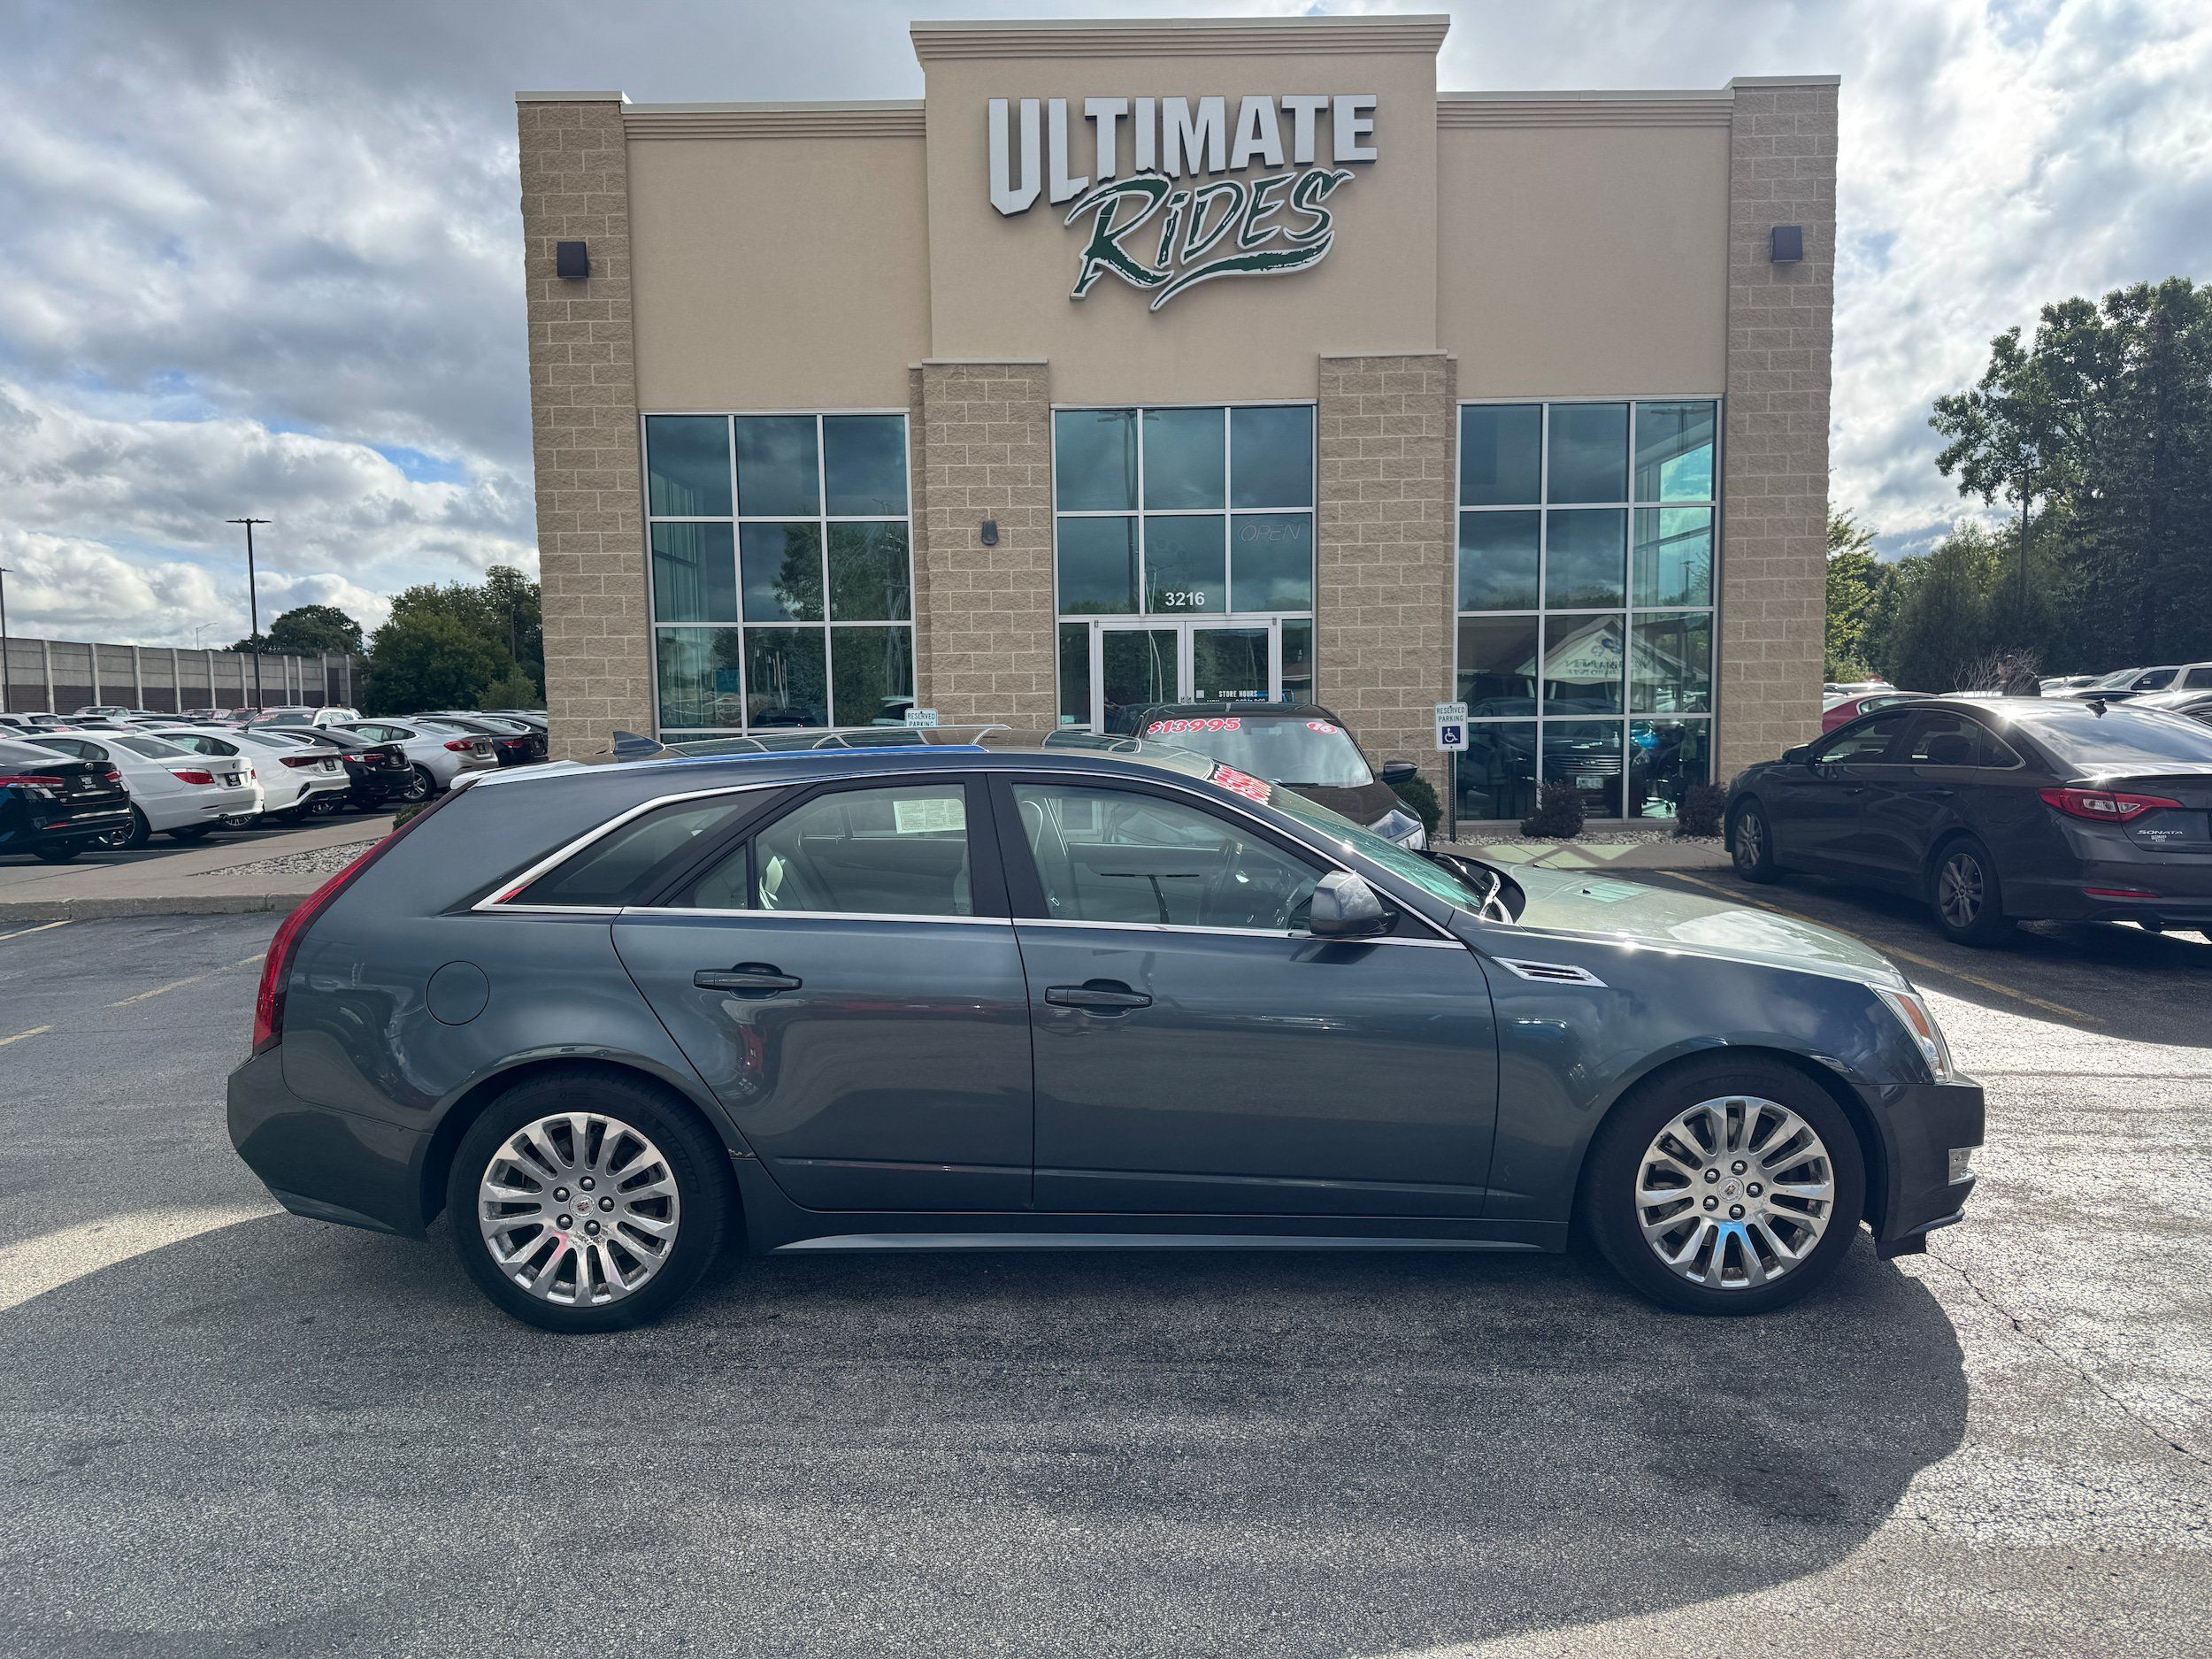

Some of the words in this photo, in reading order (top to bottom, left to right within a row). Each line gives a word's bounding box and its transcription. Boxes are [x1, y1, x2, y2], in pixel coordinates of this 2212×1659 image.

[987, 94, 1378, 218] ULTIMATE
[1240, 524, 1302, 541] OPEN
[1164, 591, 1205, 606] 3216
[1147, 718, 1241, 734] $13995
